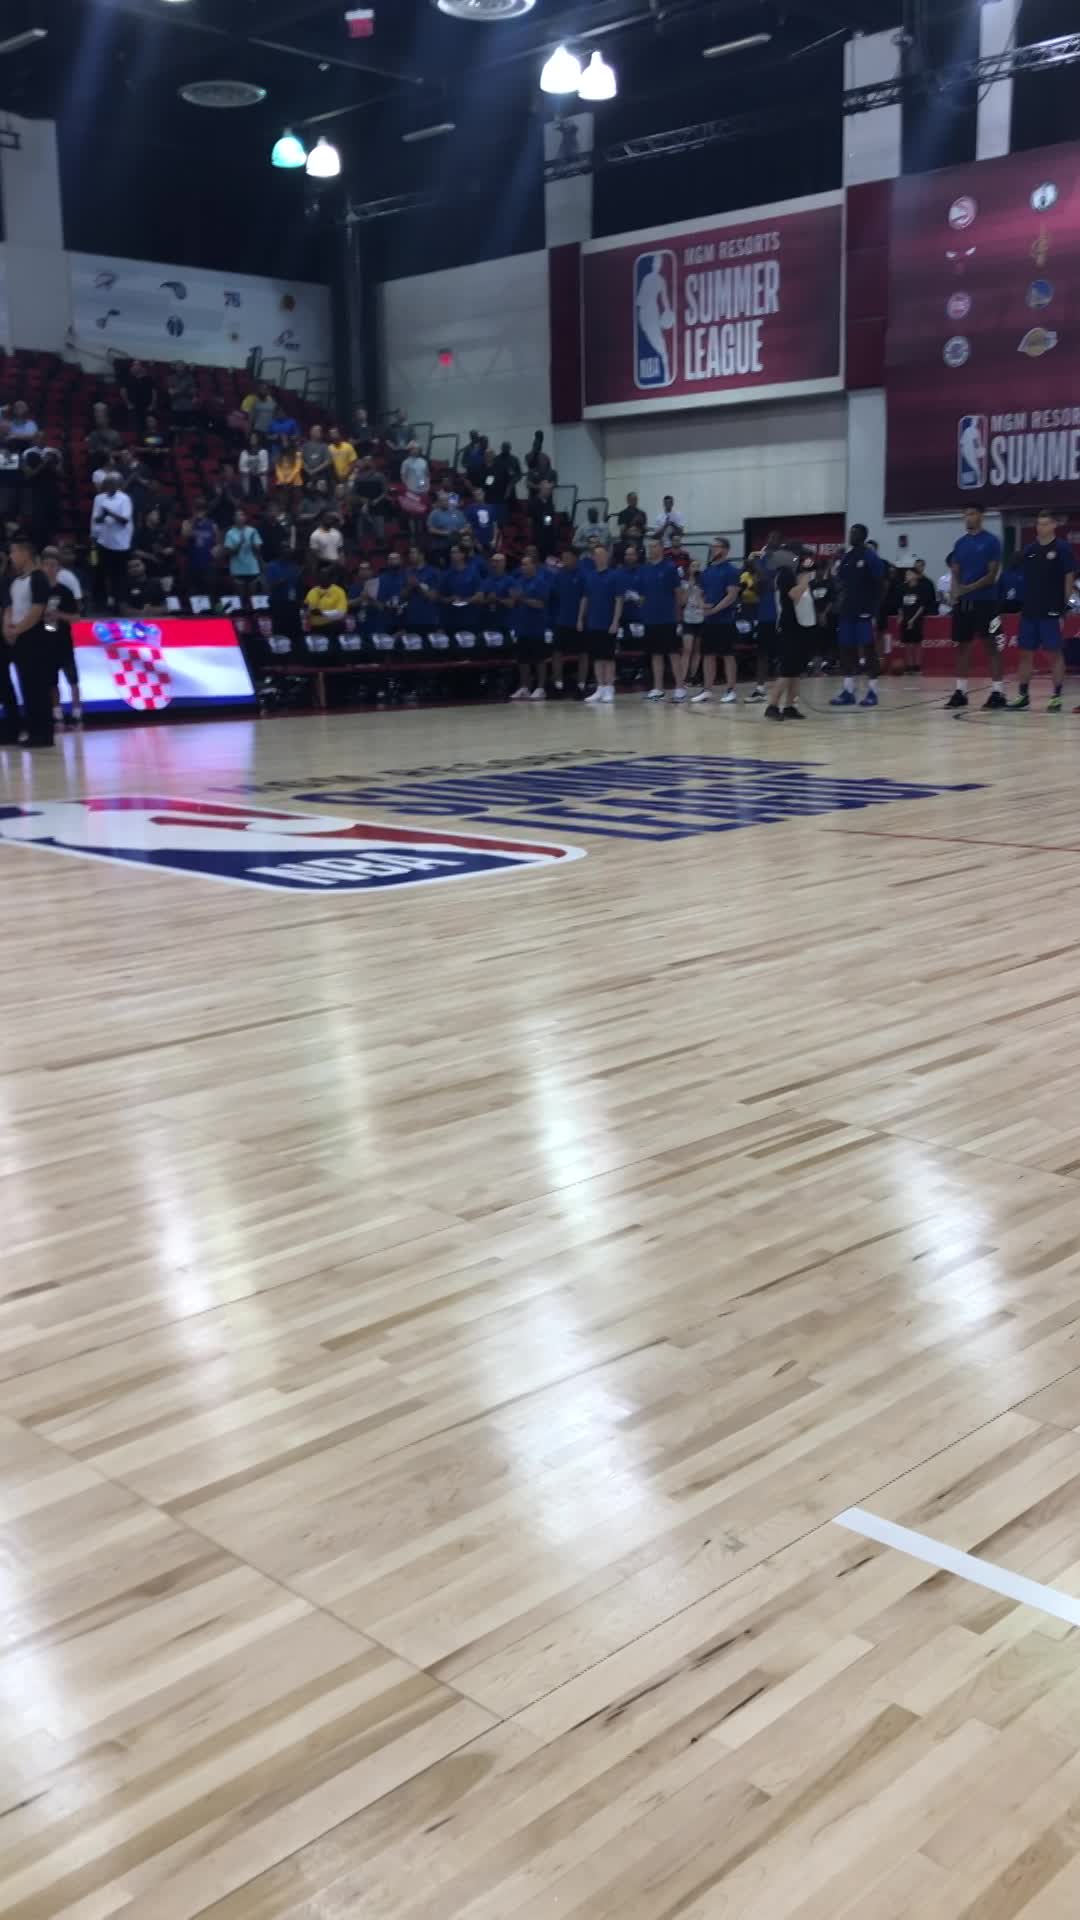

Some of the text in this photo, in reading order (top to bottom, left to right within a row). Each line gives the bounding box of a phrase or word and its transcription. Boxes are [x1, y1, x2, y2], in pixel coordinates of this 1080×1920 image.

[683, 231, 780, 266] MGM RESORTS
[684, 260, 780, 326] SUMMER
[684, 319, 764, 381] LEAGUE
[991, 412, 1026, 432] MGM
[290, 755, 828, 816] SUMMER
[460, 772, 988, 841] LEAGUE
[245, 852, 464, 886] NBA
